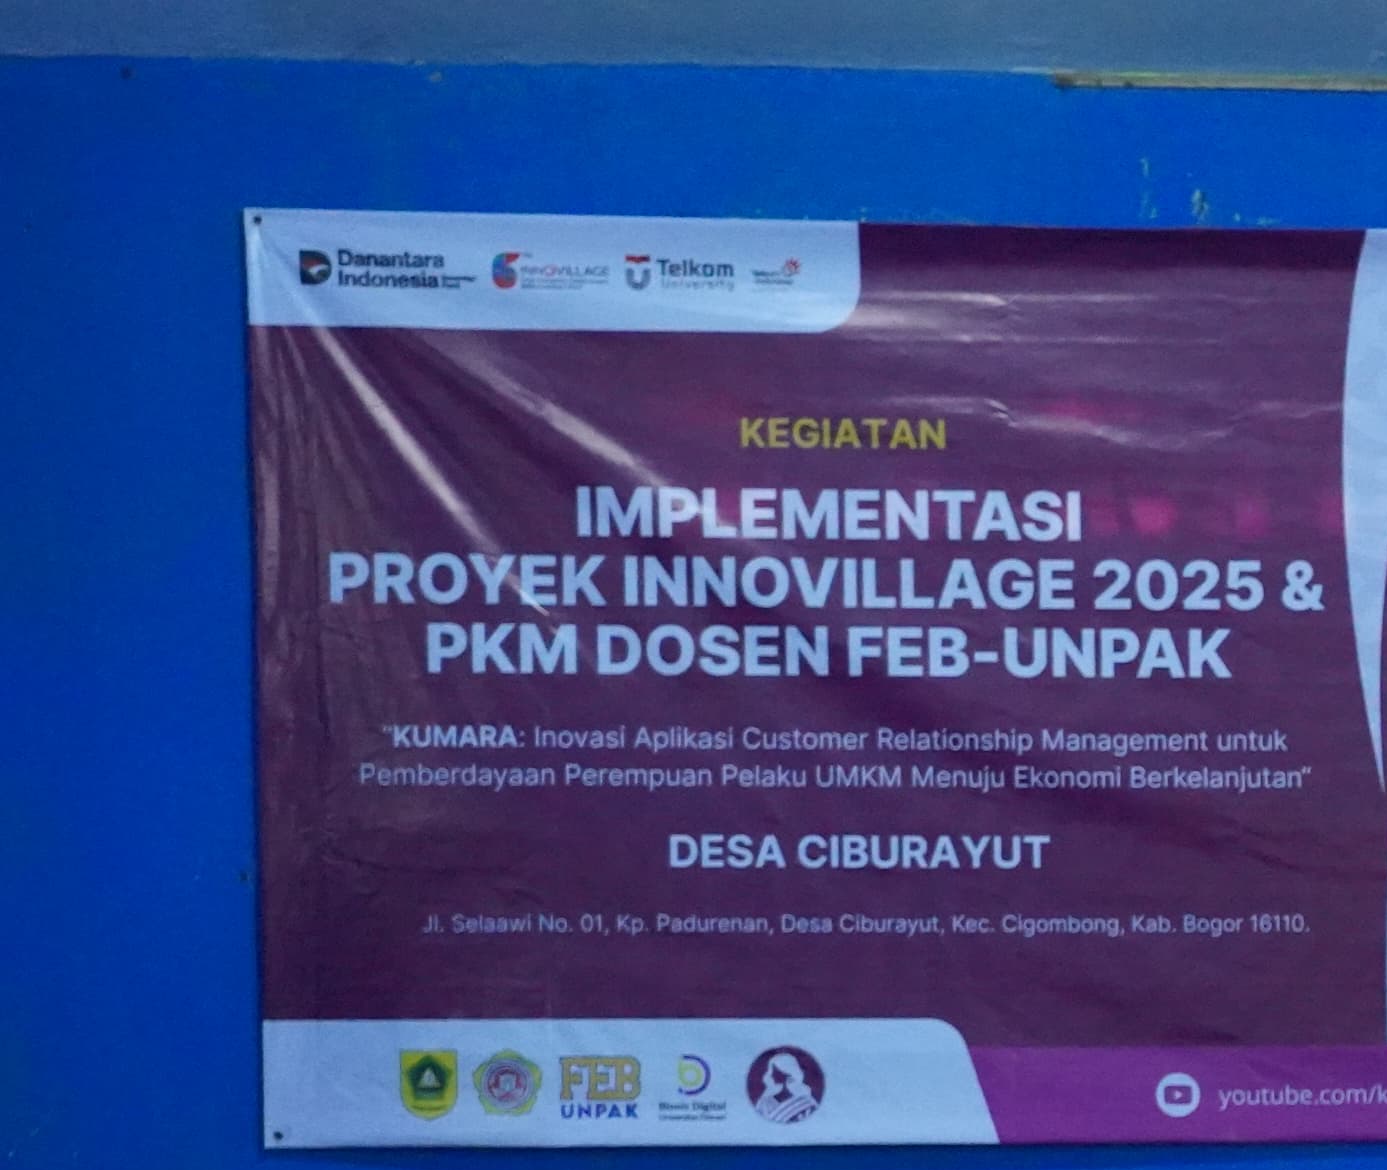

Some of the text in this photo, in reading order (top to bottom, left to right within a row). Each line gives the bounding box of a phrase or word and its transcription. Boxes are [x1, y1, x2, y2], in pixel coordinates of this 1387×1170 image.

[338, 249, 444, 269] Danantara
[656, 258, 734, 278] Telkom
[337, 270, 439, 288] Indonesia
[740, 417, 946, 450] KEGIATAN
[576, 486, 1082, 542] IMPLEMENTASI
[329, 552, 1325, 611] PROYEK INNOVILLAGE 2025 &
[426, 622, 1233, 679] PKM DOSEN FEB-UNPAK
[534, 724, 626, 750] Inovasi
[633, 725, 734, 755] Aplikasi
[742, 726, 869, 751] Customer
[876, 726, 1034, 756] Relationship
[1041, 728, 1209, 758] Management
[1216, 729, 1288, 752] untuk
[359, 762, 556, 793] Pemberdayaan
[564, 762, 713, 792] Perempuan
[720, 763, 807, 788] Pelaku
[815, 764, 902, 788] UMKM
[911, 765, 1006, 794] Menuju
[1013, 764, 1122, 789] Ekonomi
[669, 833, 1051, 869] DESA CIBURAYUT
[423, 914, 444, 934] Jl.
[538, 913, 573, 934] No.
[579, 912, 609, 937] 01,
[615, 913, 649, 937] Kp.
[655, 912, 774, 936] Padurenan,
[780, 913, 833, 934] Desa
[838, 913, 945, 938] Ciburayut,
[951, 914, 995, 934] Kec.
[1001, 913, 1126, 938] Cigombong,
[1130, 914, 1177, 934] Kab.
[1182, 913, 1244, 938] Bogor
[1249, 912, 1311, 934] 16110.
[559, 1055, 642, 1100] FEB
[560, 1103, 639, 1119] UNPAK
